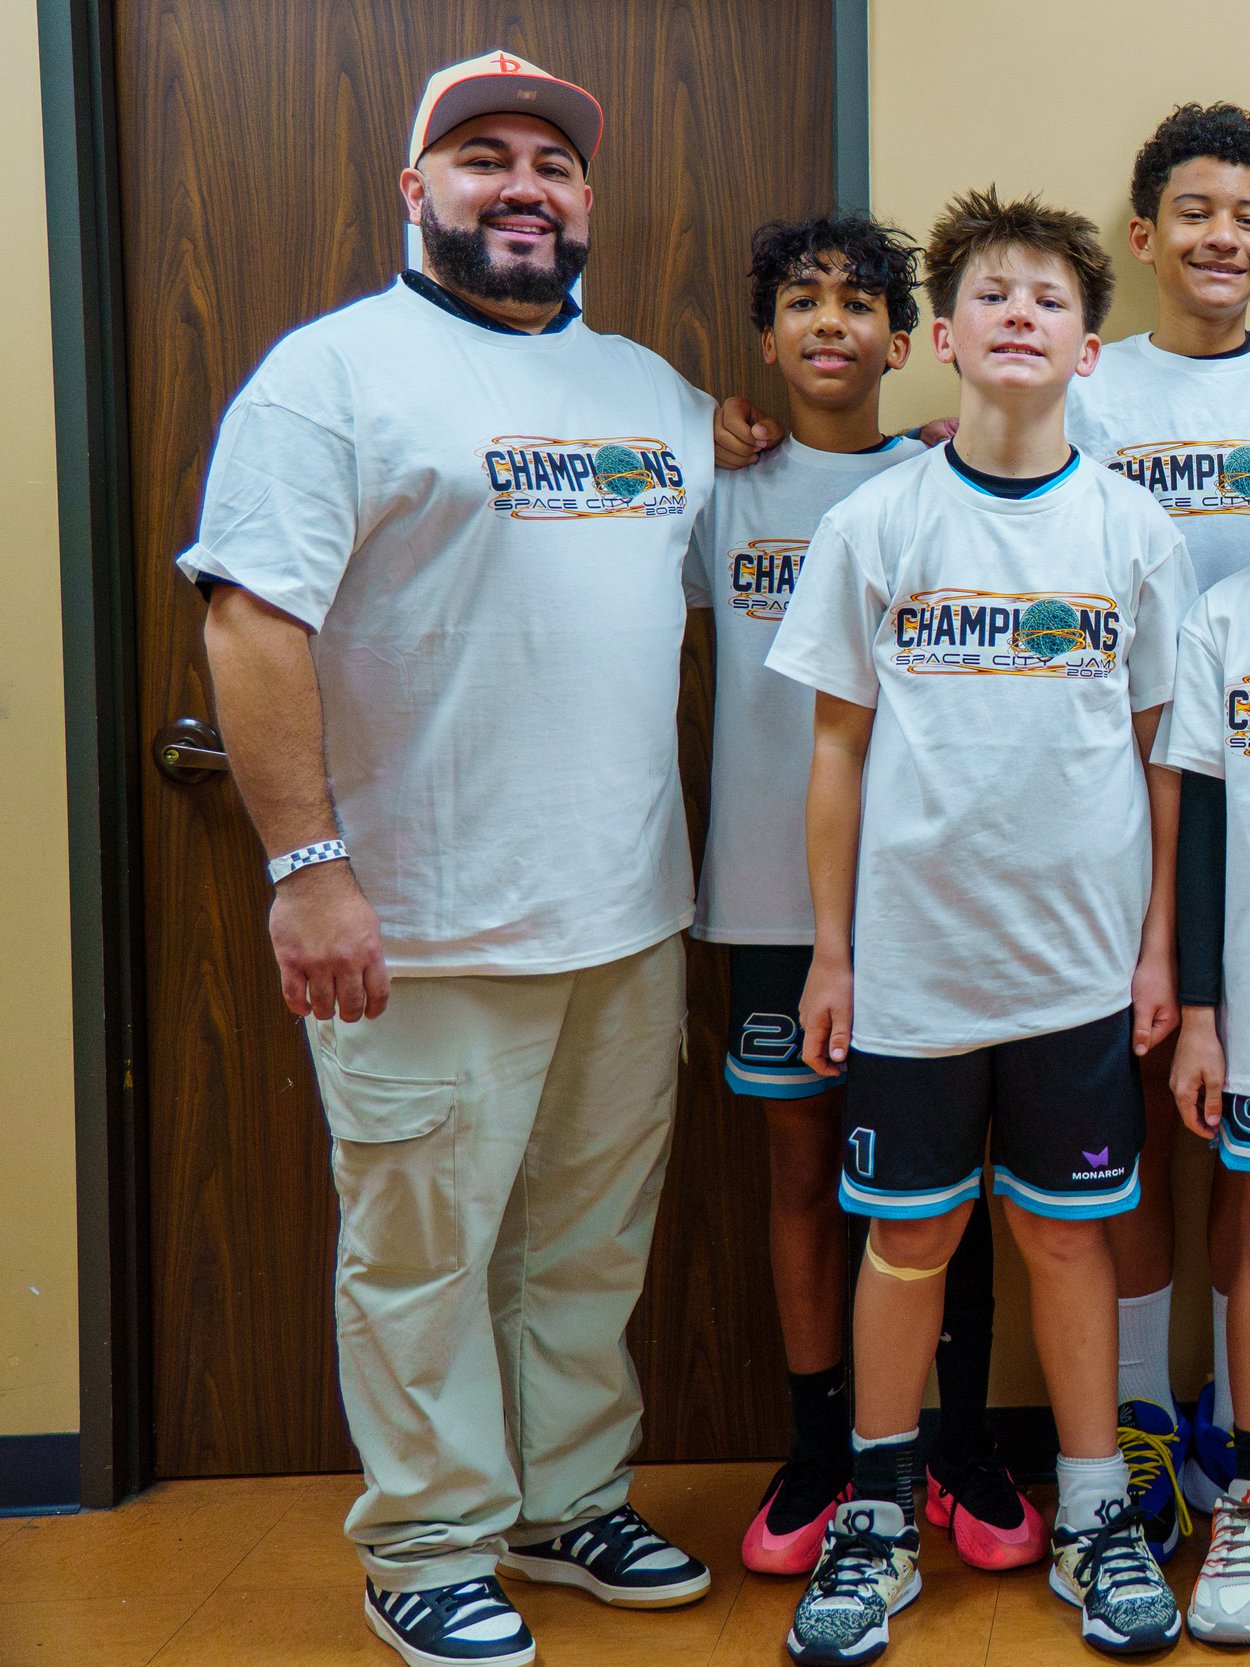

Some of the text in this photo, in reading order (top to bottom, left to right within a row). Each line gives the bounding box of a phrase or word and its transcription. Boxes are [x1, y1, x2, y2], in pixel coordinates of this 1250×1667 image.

[494, 495, 684, 511] SPACE CITY JAM
[895, 653, 980, 665] SPACE
[992, 655, 1053, 666] CITY
[740, 1012, 803, 1061] 2
[848, 1127, 876, 1179] 1
[1072, 1167, 1125, 1180] MONARCH
